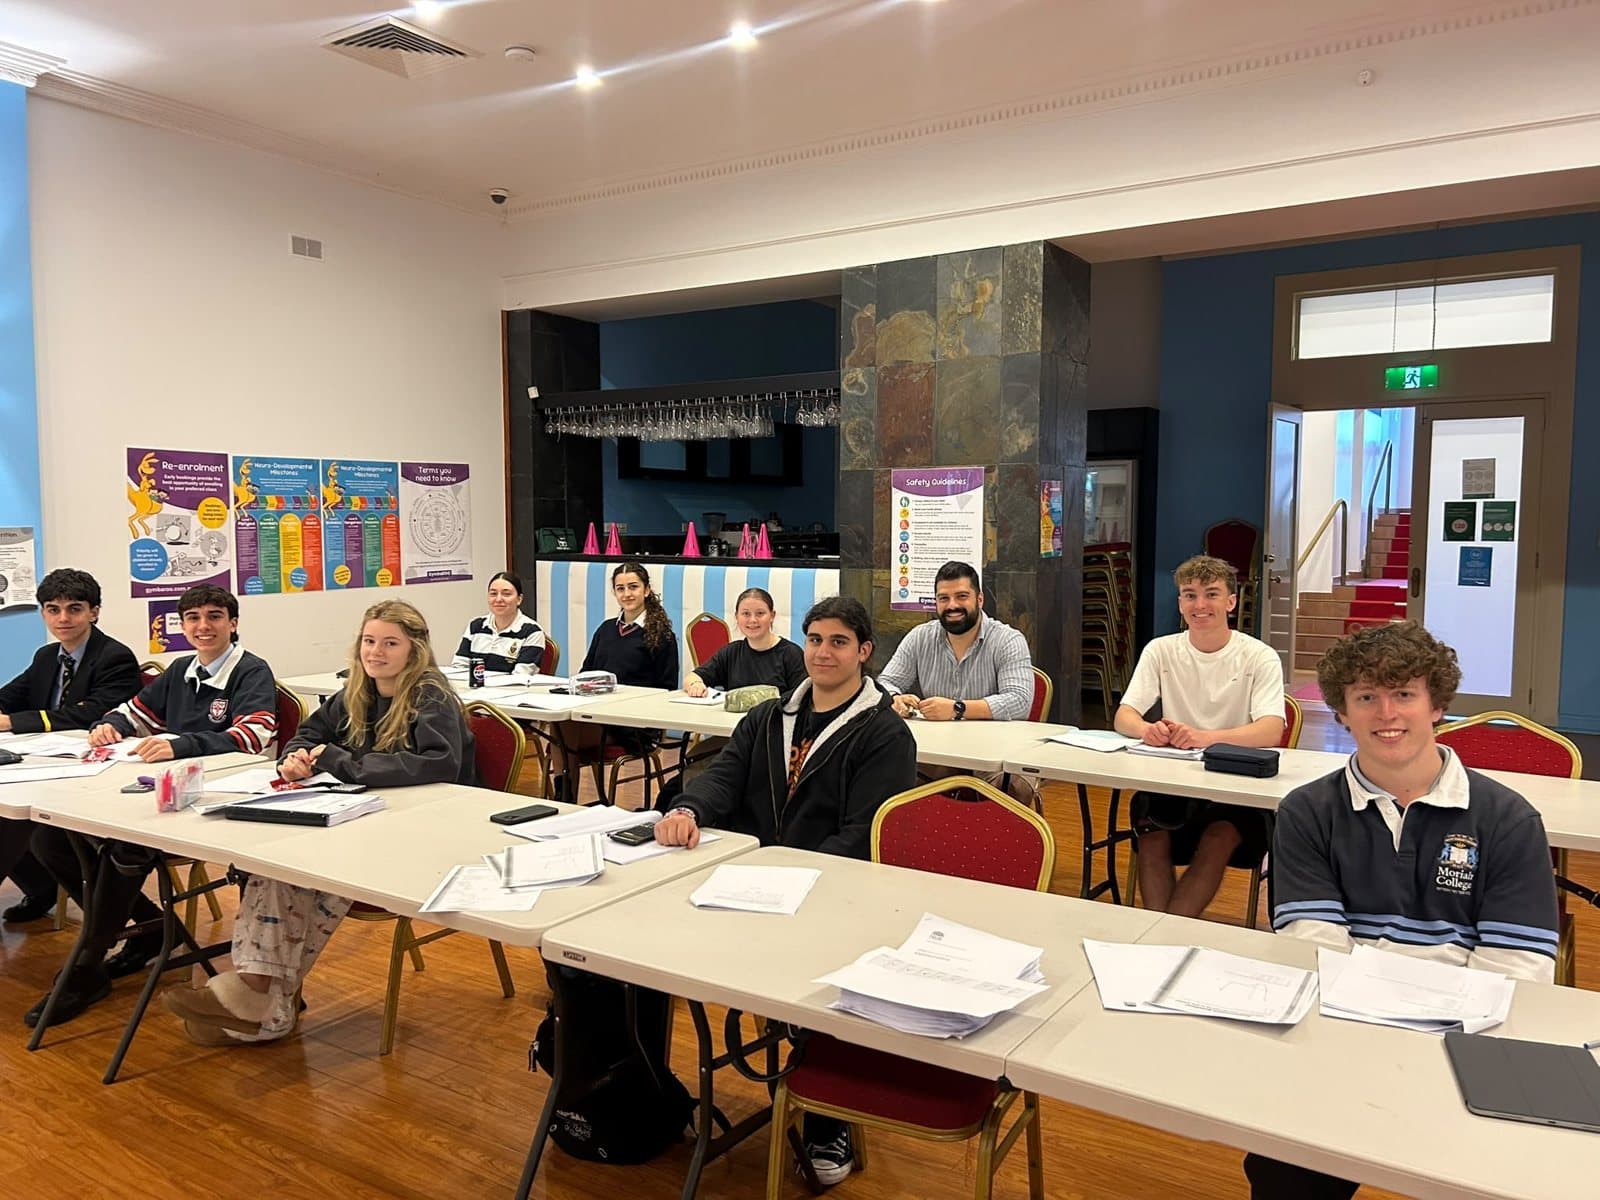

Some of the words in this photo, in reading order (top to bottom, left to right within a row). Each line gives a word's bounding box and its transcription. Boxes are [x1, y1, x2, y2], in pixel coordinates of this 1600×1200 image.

[162, 461, 225, 472] Re-enrolment
[418, 466, 439, 474] Terms
[905, 478, 931, 488] Safety
[931, 478, 967, 486] Guidelines
[1438, 866, 1474, 880] Moriah
[1436, 876, 1472, 891] College
